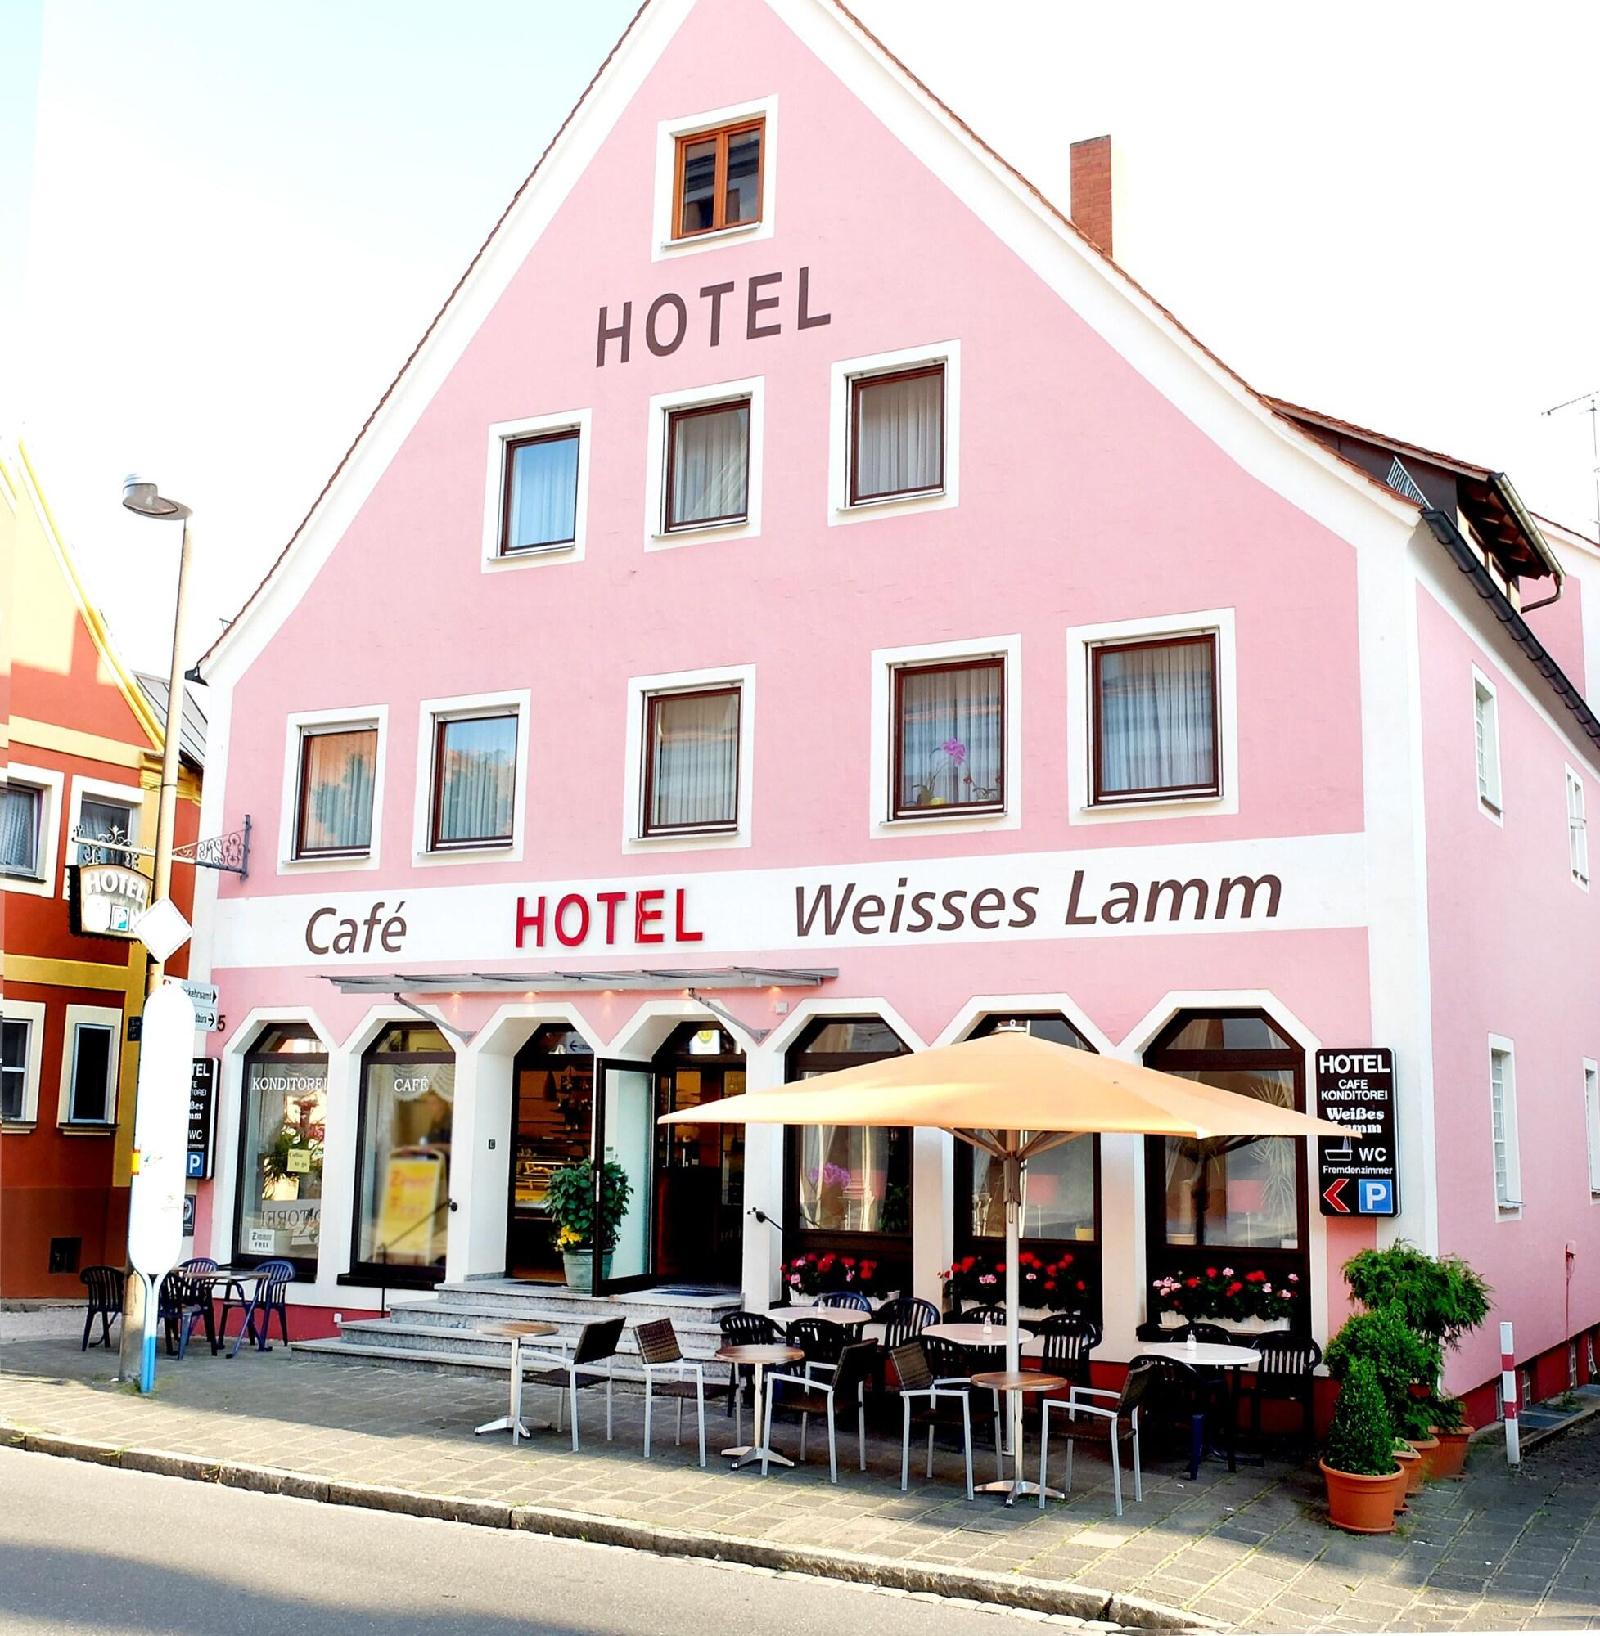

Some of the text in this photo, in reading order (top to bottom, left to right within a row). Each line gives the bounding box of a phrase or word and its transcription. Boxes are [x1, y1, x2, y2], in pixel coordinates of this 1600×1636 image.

[597, 266, 831, 368] HOTEL
[86, 871, 146, 903] HOTEL
[795, 870, 1283, 937] Weisses Lamm
[515, 888, 704, 949] HOTEL
[305, 901, 407, 955] Café
[217, 1015, 226, 1031] 5
[191, 1063, 210, 1077] TEL
[1319, 1054, 1391, 1074] HOTEL
[393, 1076, 430, 1092] CAFÉ
[1338, 1079, 1369, 1089] CAFE
[1321, 1090, 1388, 1100] KONDITOREI
[1326, 1107, 1385, 1120] Weißes
[188, 1129, 203, 1140] WC
[1358, 1147, 1387, 1162] WC
[189, 1154, 201, 1174] P
[1322, 1165, 1393, 1175] Fremdenzimmer
[1366, 1183, 1387, 1210] P
